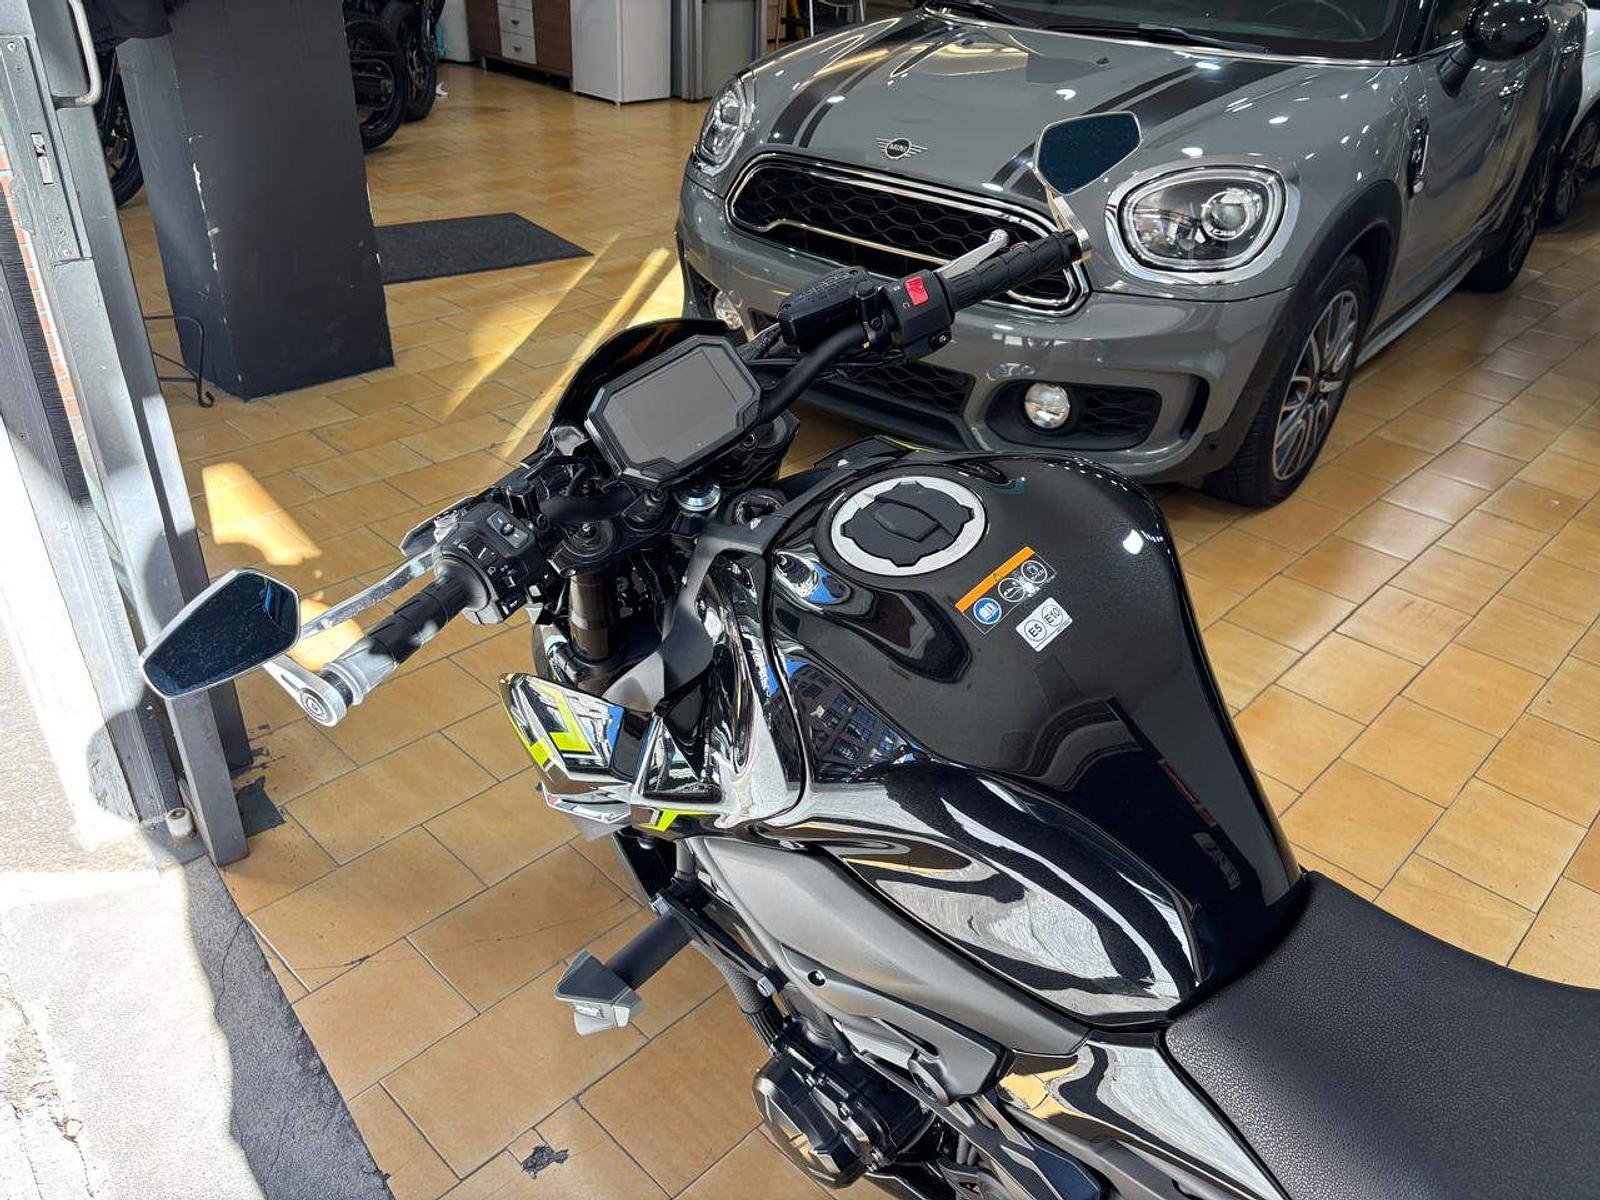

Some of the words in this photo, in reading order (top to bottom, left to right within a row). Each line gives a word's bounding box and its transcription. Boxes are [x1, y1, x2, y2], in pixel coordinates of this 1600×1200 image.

[888, 143, 908, 152] MINI
[1028, 623, 1043, 637] E5
[1043, 607, 1061, 623] E10
